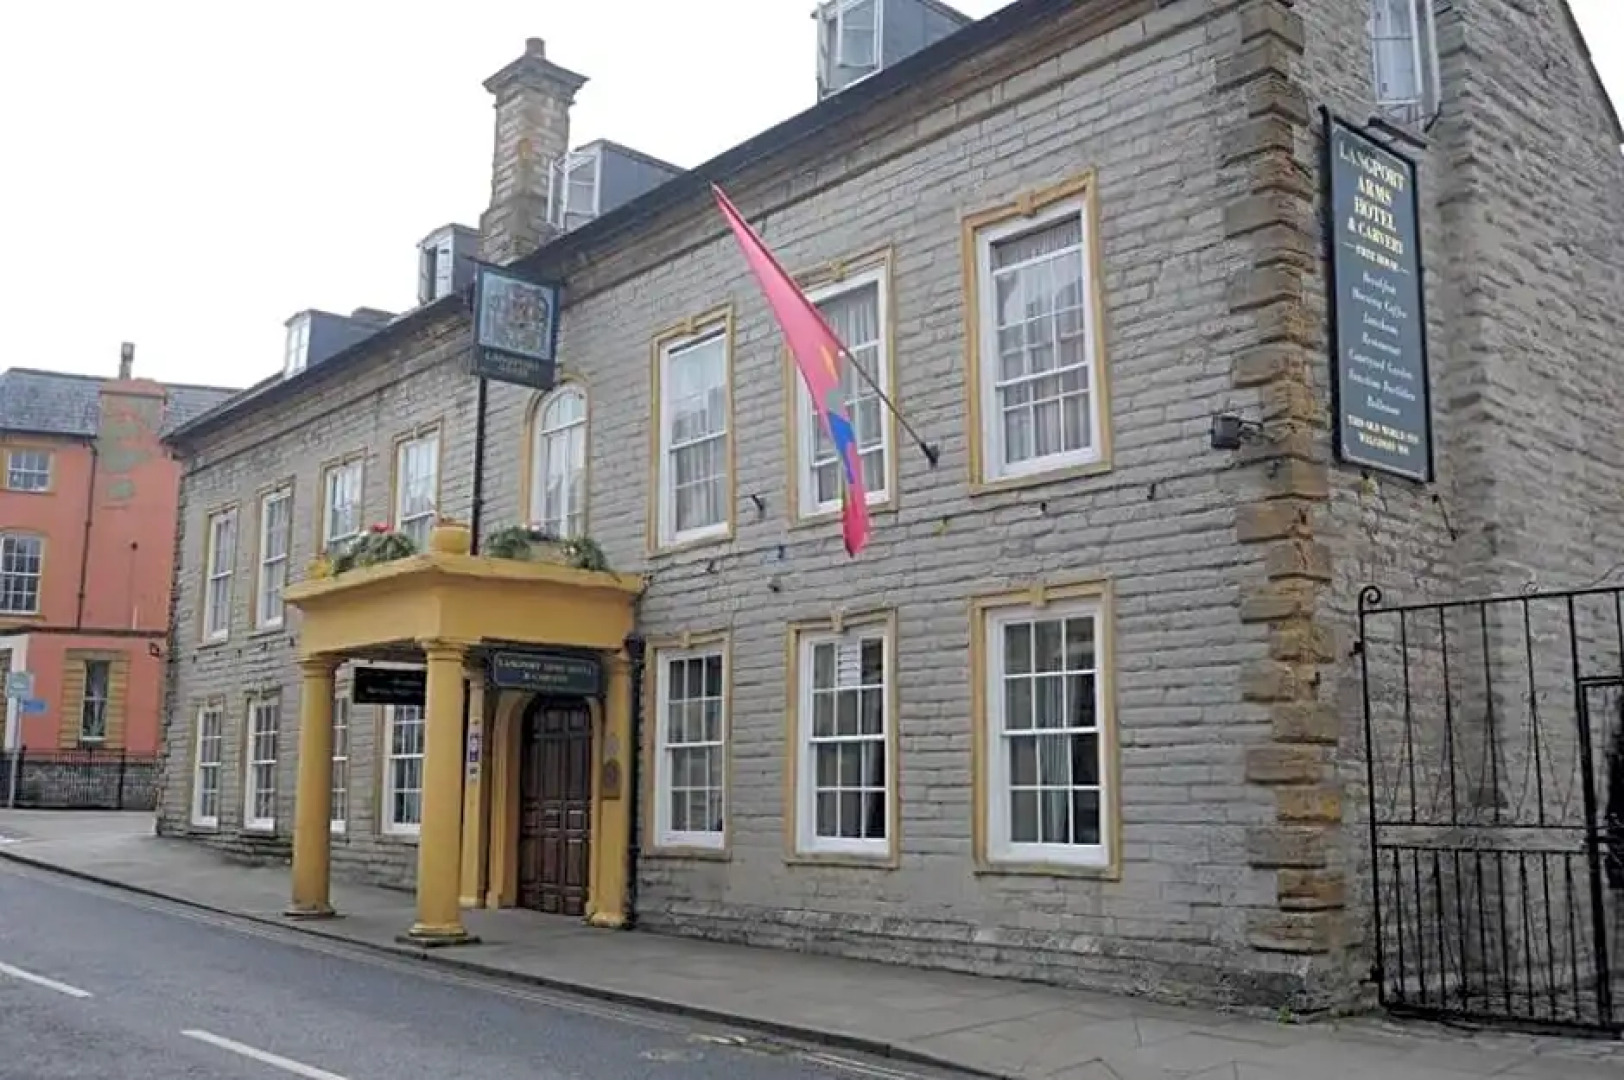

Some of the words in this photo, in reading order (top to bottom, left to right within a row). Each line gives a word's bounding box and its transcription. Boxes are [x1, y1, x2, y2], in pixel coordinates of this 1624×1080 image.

[1340, 141, 1404, 192] LANGPORT
[1359, 176, 1392, 207] ARMS
[1354, 195, 1397, 233] HOTEL
[1358, 222, 1404, 255] CARVERY
